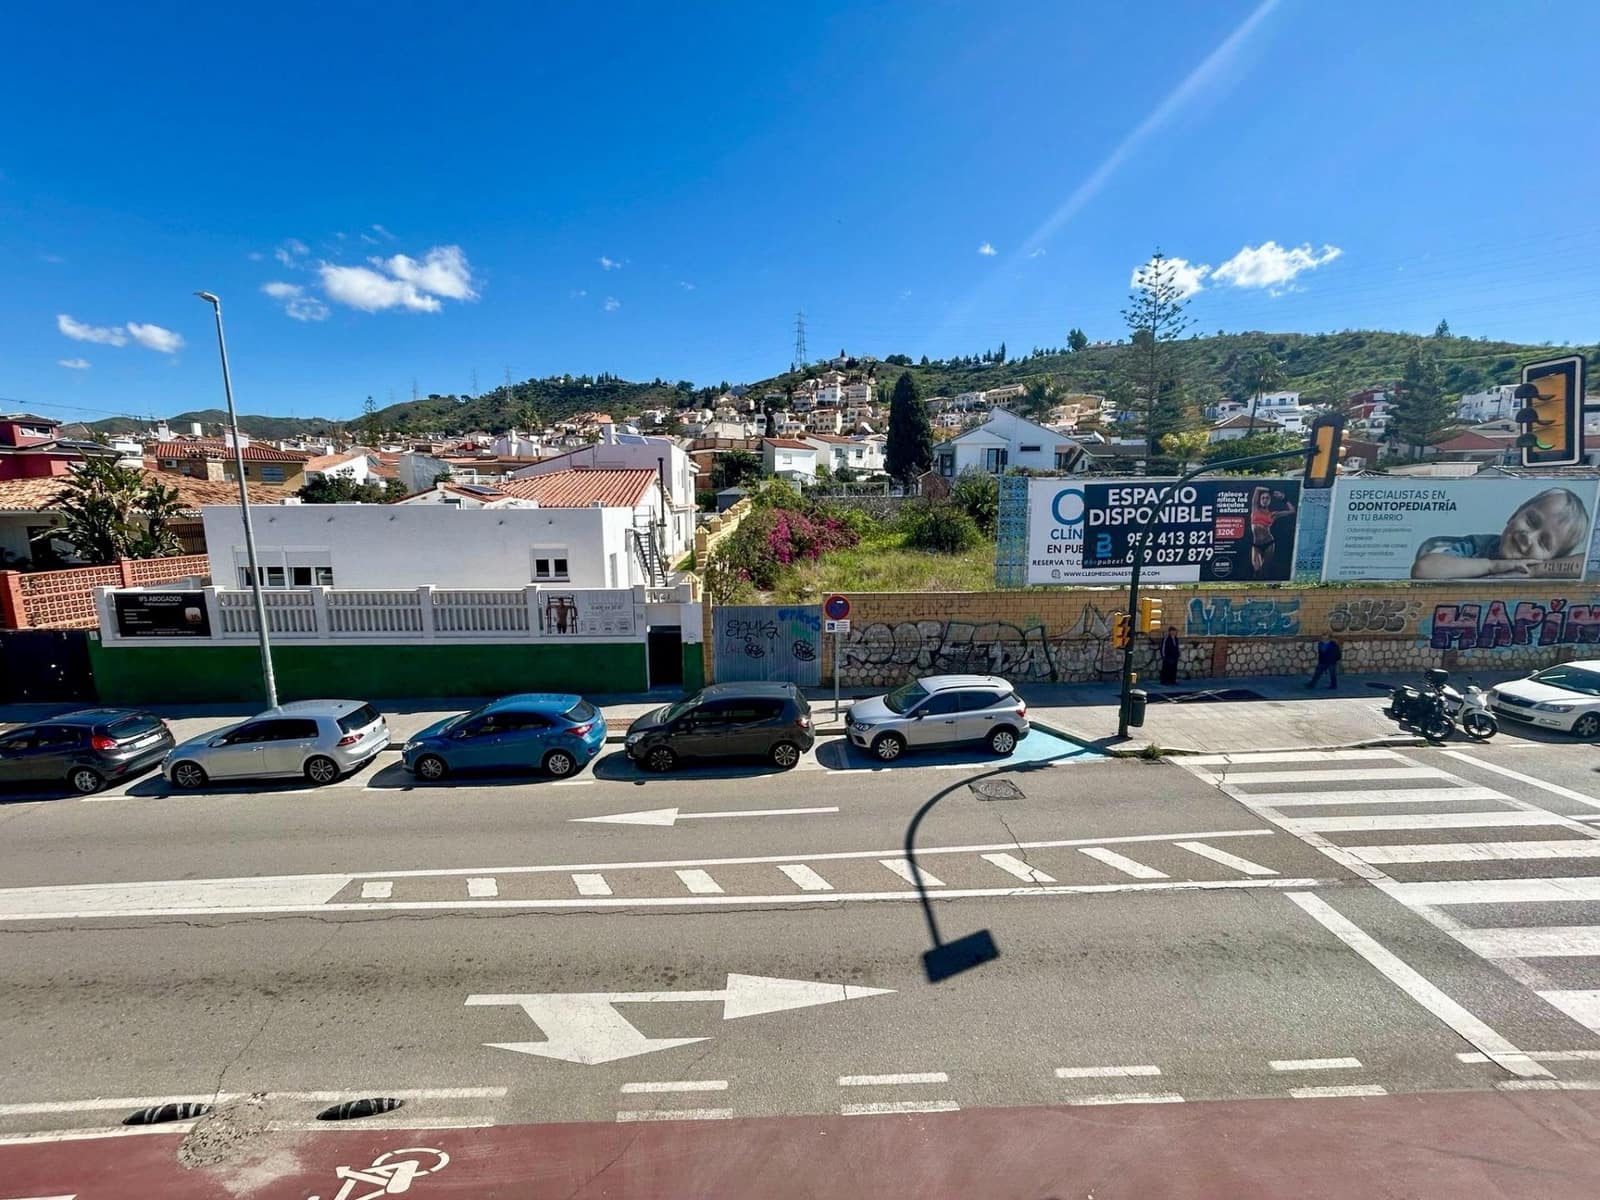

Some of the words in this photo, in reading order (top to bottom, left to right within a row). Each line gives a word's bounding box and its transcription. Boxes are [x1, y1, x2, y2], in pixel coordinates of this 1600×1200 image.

[1108, 486, 1197, 506] ESPACIO
[1350, 489, 1429, 500] ESPECIALISTAS
[1431, 489, 1446, 500] EN
[1348, 499, 1457, 511] ODONTOPEDIATRÍA
[1089, 505, 1213, 526] DISPONIBLE
[1347, 513, 1358, 521] EN
[1372, 513, 1403, 521] BARRIO
[1050, 525, 1083, 540] CLÍN
[1157, 531, 1184, 546] 413
[1189, 530, 1213, 545] 821
[1047, 544, 1061, 554] EN
[1125, 549, 1152, 563] 69
[1157, 548, 1184, 562] 037
[1187, 547, 1214, 561] 879
